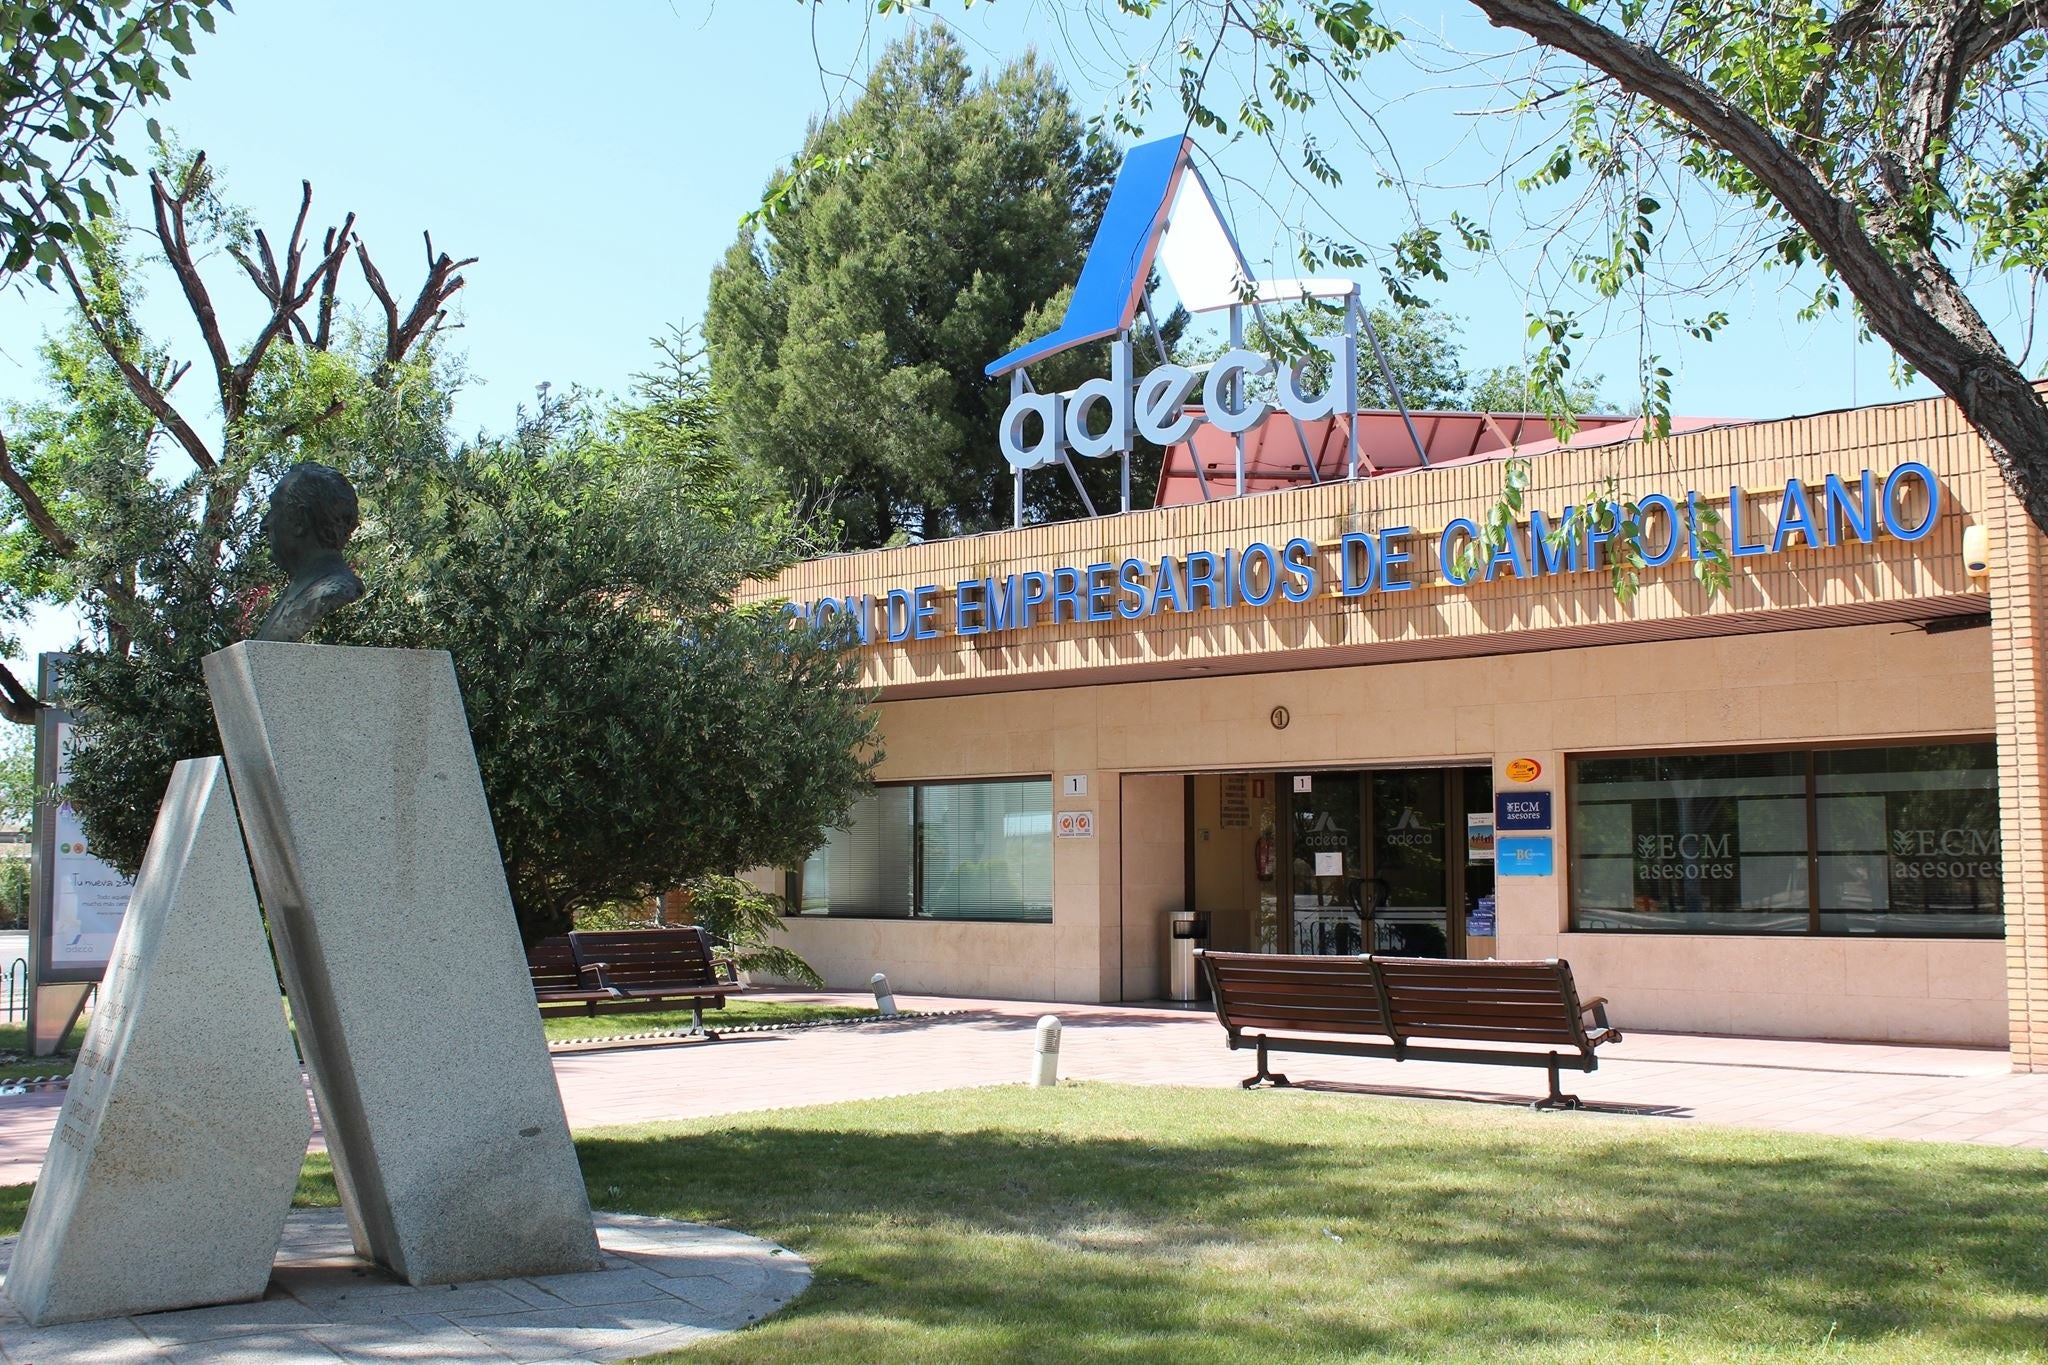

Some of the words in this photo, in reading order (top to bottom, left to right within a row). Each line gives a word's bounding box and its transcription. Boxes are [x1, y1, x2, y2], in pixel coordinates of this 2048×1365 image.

[1000, 336, 1352, 469] adeca
[888, 584, 940, 642] DE
[957, 537, 1316, 635] EMPRESARIOS
[1342, 526, 1416, 596] DE
[1440, 461, 1940, 586] CAMPOLLANO
[1513, 802, 1539, 812] ECM
[1507, 812, 1540, 820] asesores
[1305, 833, 1348, 846] adeca
[1387, 831, 1432, 845] adeca
[1657, 833, 1732, 859] ECM
[1915, 829, 2001, 857] ECM
[1640, 863, 1734, 880] asesores
[1896, 861, 2003, 879] asesores
[72, 872, 83, 887] Tu
